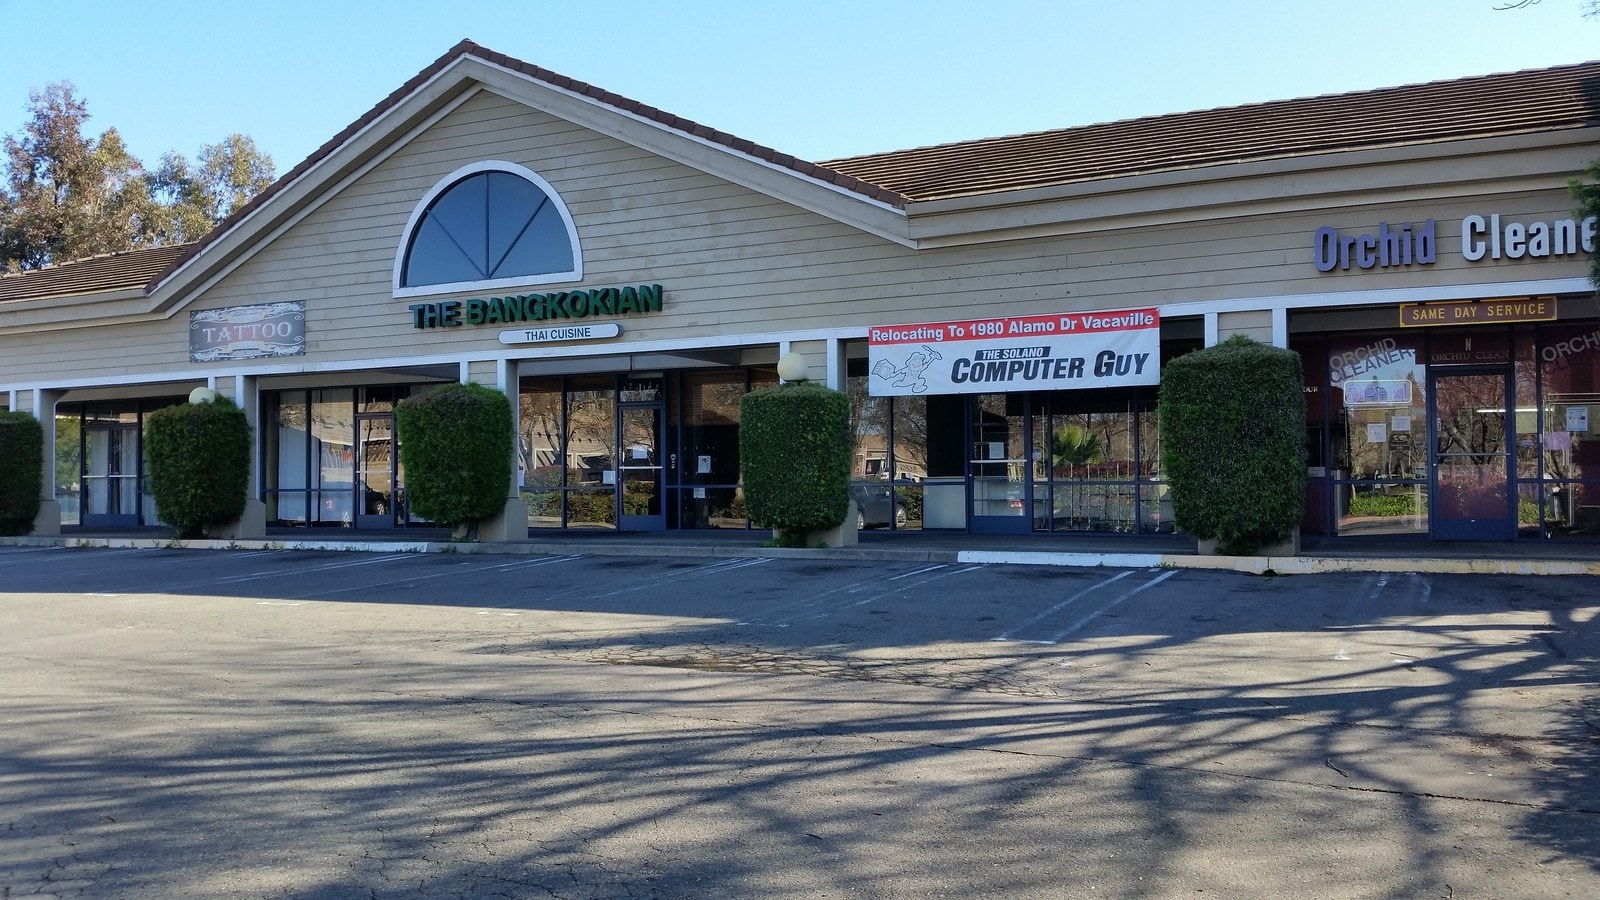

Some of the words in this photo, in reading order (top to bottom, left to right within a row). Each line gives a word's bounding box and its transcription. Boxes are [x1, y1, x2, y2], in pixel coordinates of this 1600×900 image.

[1314, 218, 1436, 272] Orchid
[409, 301, 461, 329] THE
[466, 284, 663, 325] BANGKOKIAN
[1412, 308, 1445, 320] SAME
[1454, 306, 1477, 318] DAY
[1487, 303, 1545, 317] SERVICE
[203, 322, 292, 343] TATTOO
[525, 330, 548, 341] THAI
[550, 327, 591, 339] CUISINE
[872, 327, 944, 342] Relocating
[948, 325, 964, 337] To
[969, 322, 1004, 336] 1980
[1008, 320, 1055, 334] Alamo
[1060, 317, 1077, 330] Dr
[1081, 313, 1154, 329] Vacaville
[982, 349, 1001, 360] THE
[1002, 347, 1044, 359] SOLANO
[1329, 337, 1396, 370] ORCHID
[951, 356, 1085, 384] COMPUTER
[1093, 350, 1150, 377] GUY
[1345, 383, 1408, 402] OPEN
